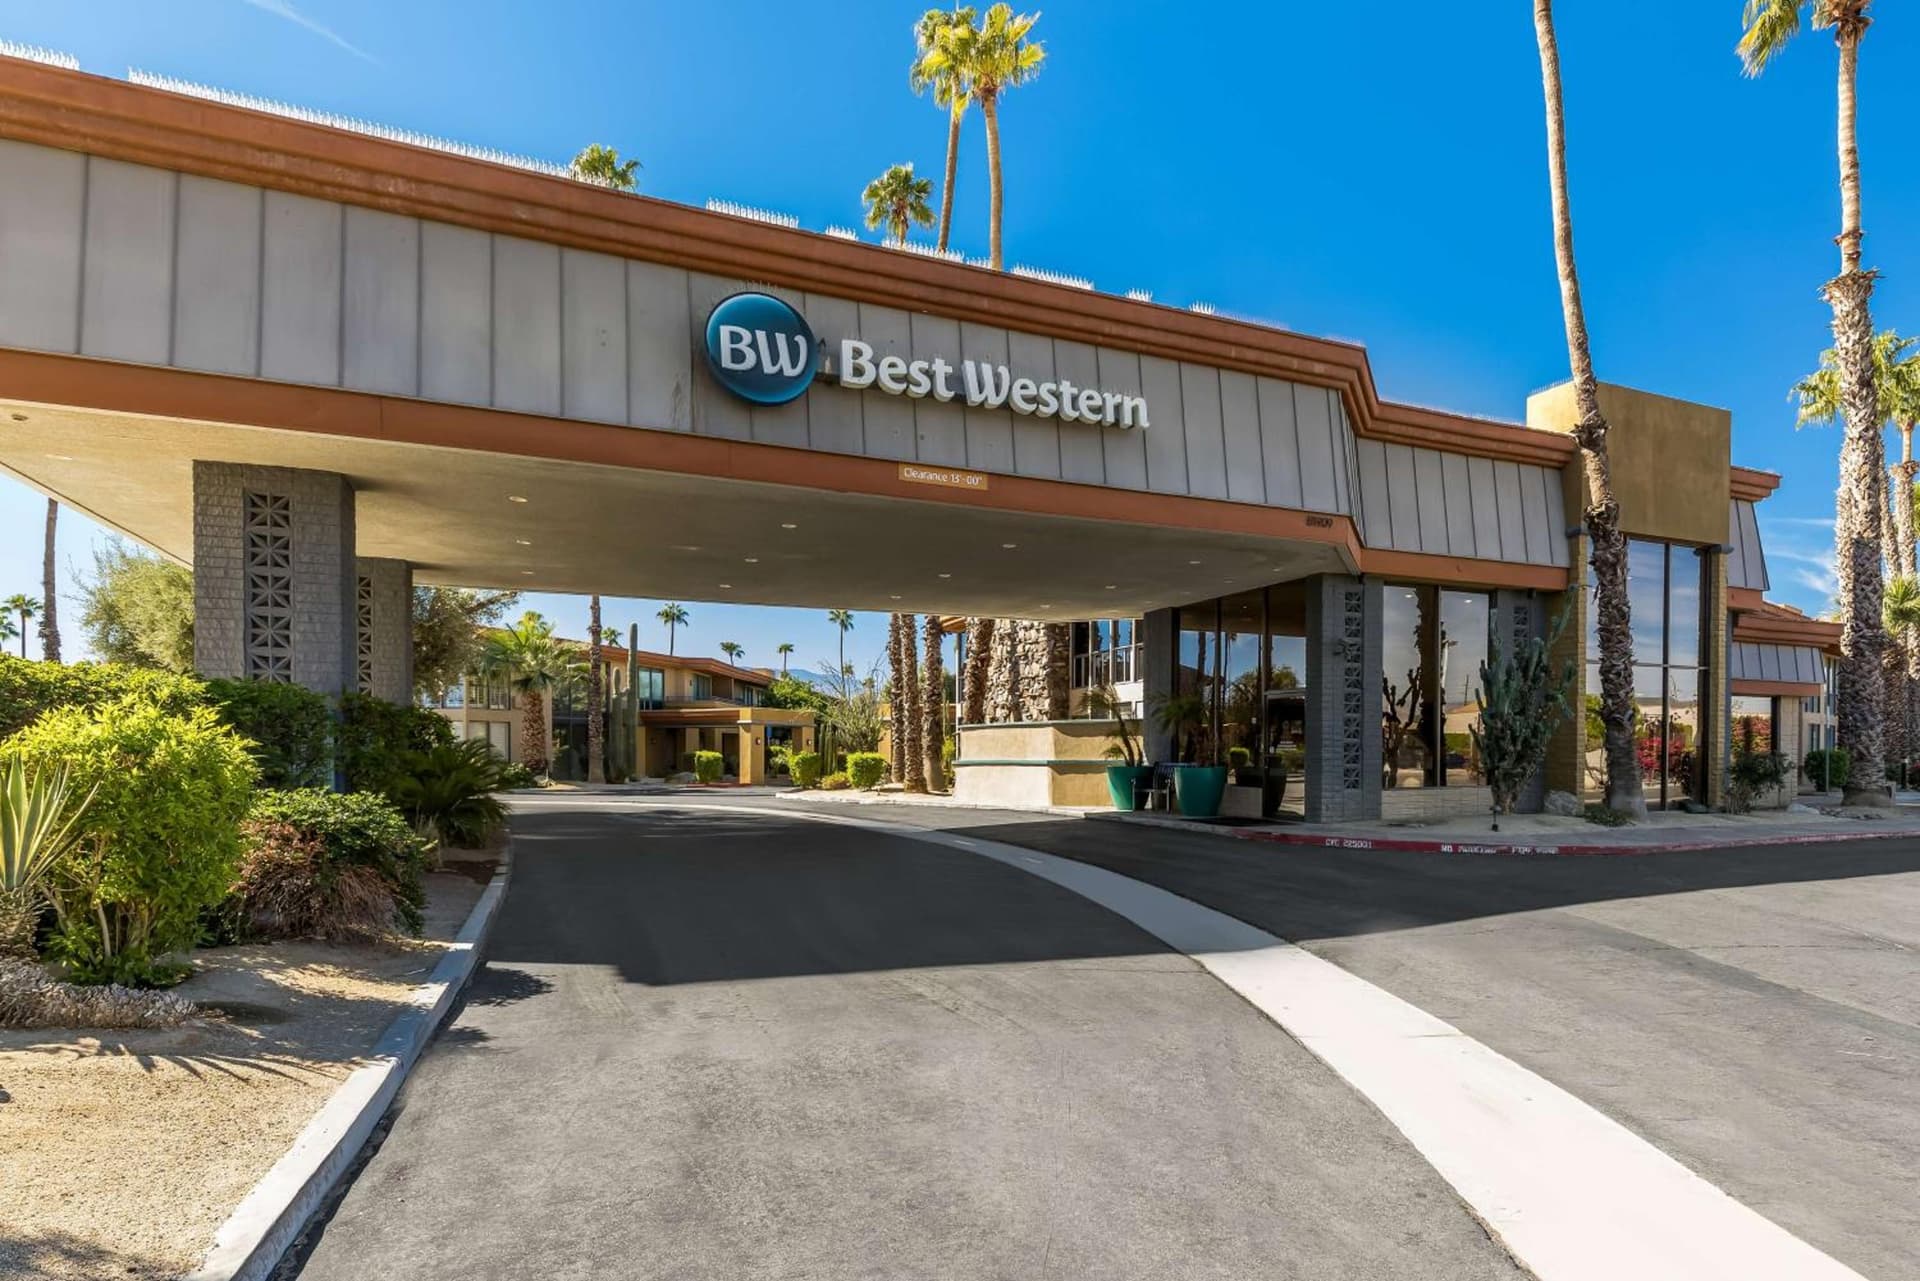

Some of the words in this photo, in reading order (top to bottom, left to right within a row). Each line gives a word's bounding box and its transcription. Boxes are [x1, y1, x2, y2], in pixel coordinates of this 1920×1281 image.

[720, 325, 808, 377] BW
[840, 339, 955, 402] Best
[962, 360, 1150, 430] Western
[903, 467, 948, 482] Clearance
